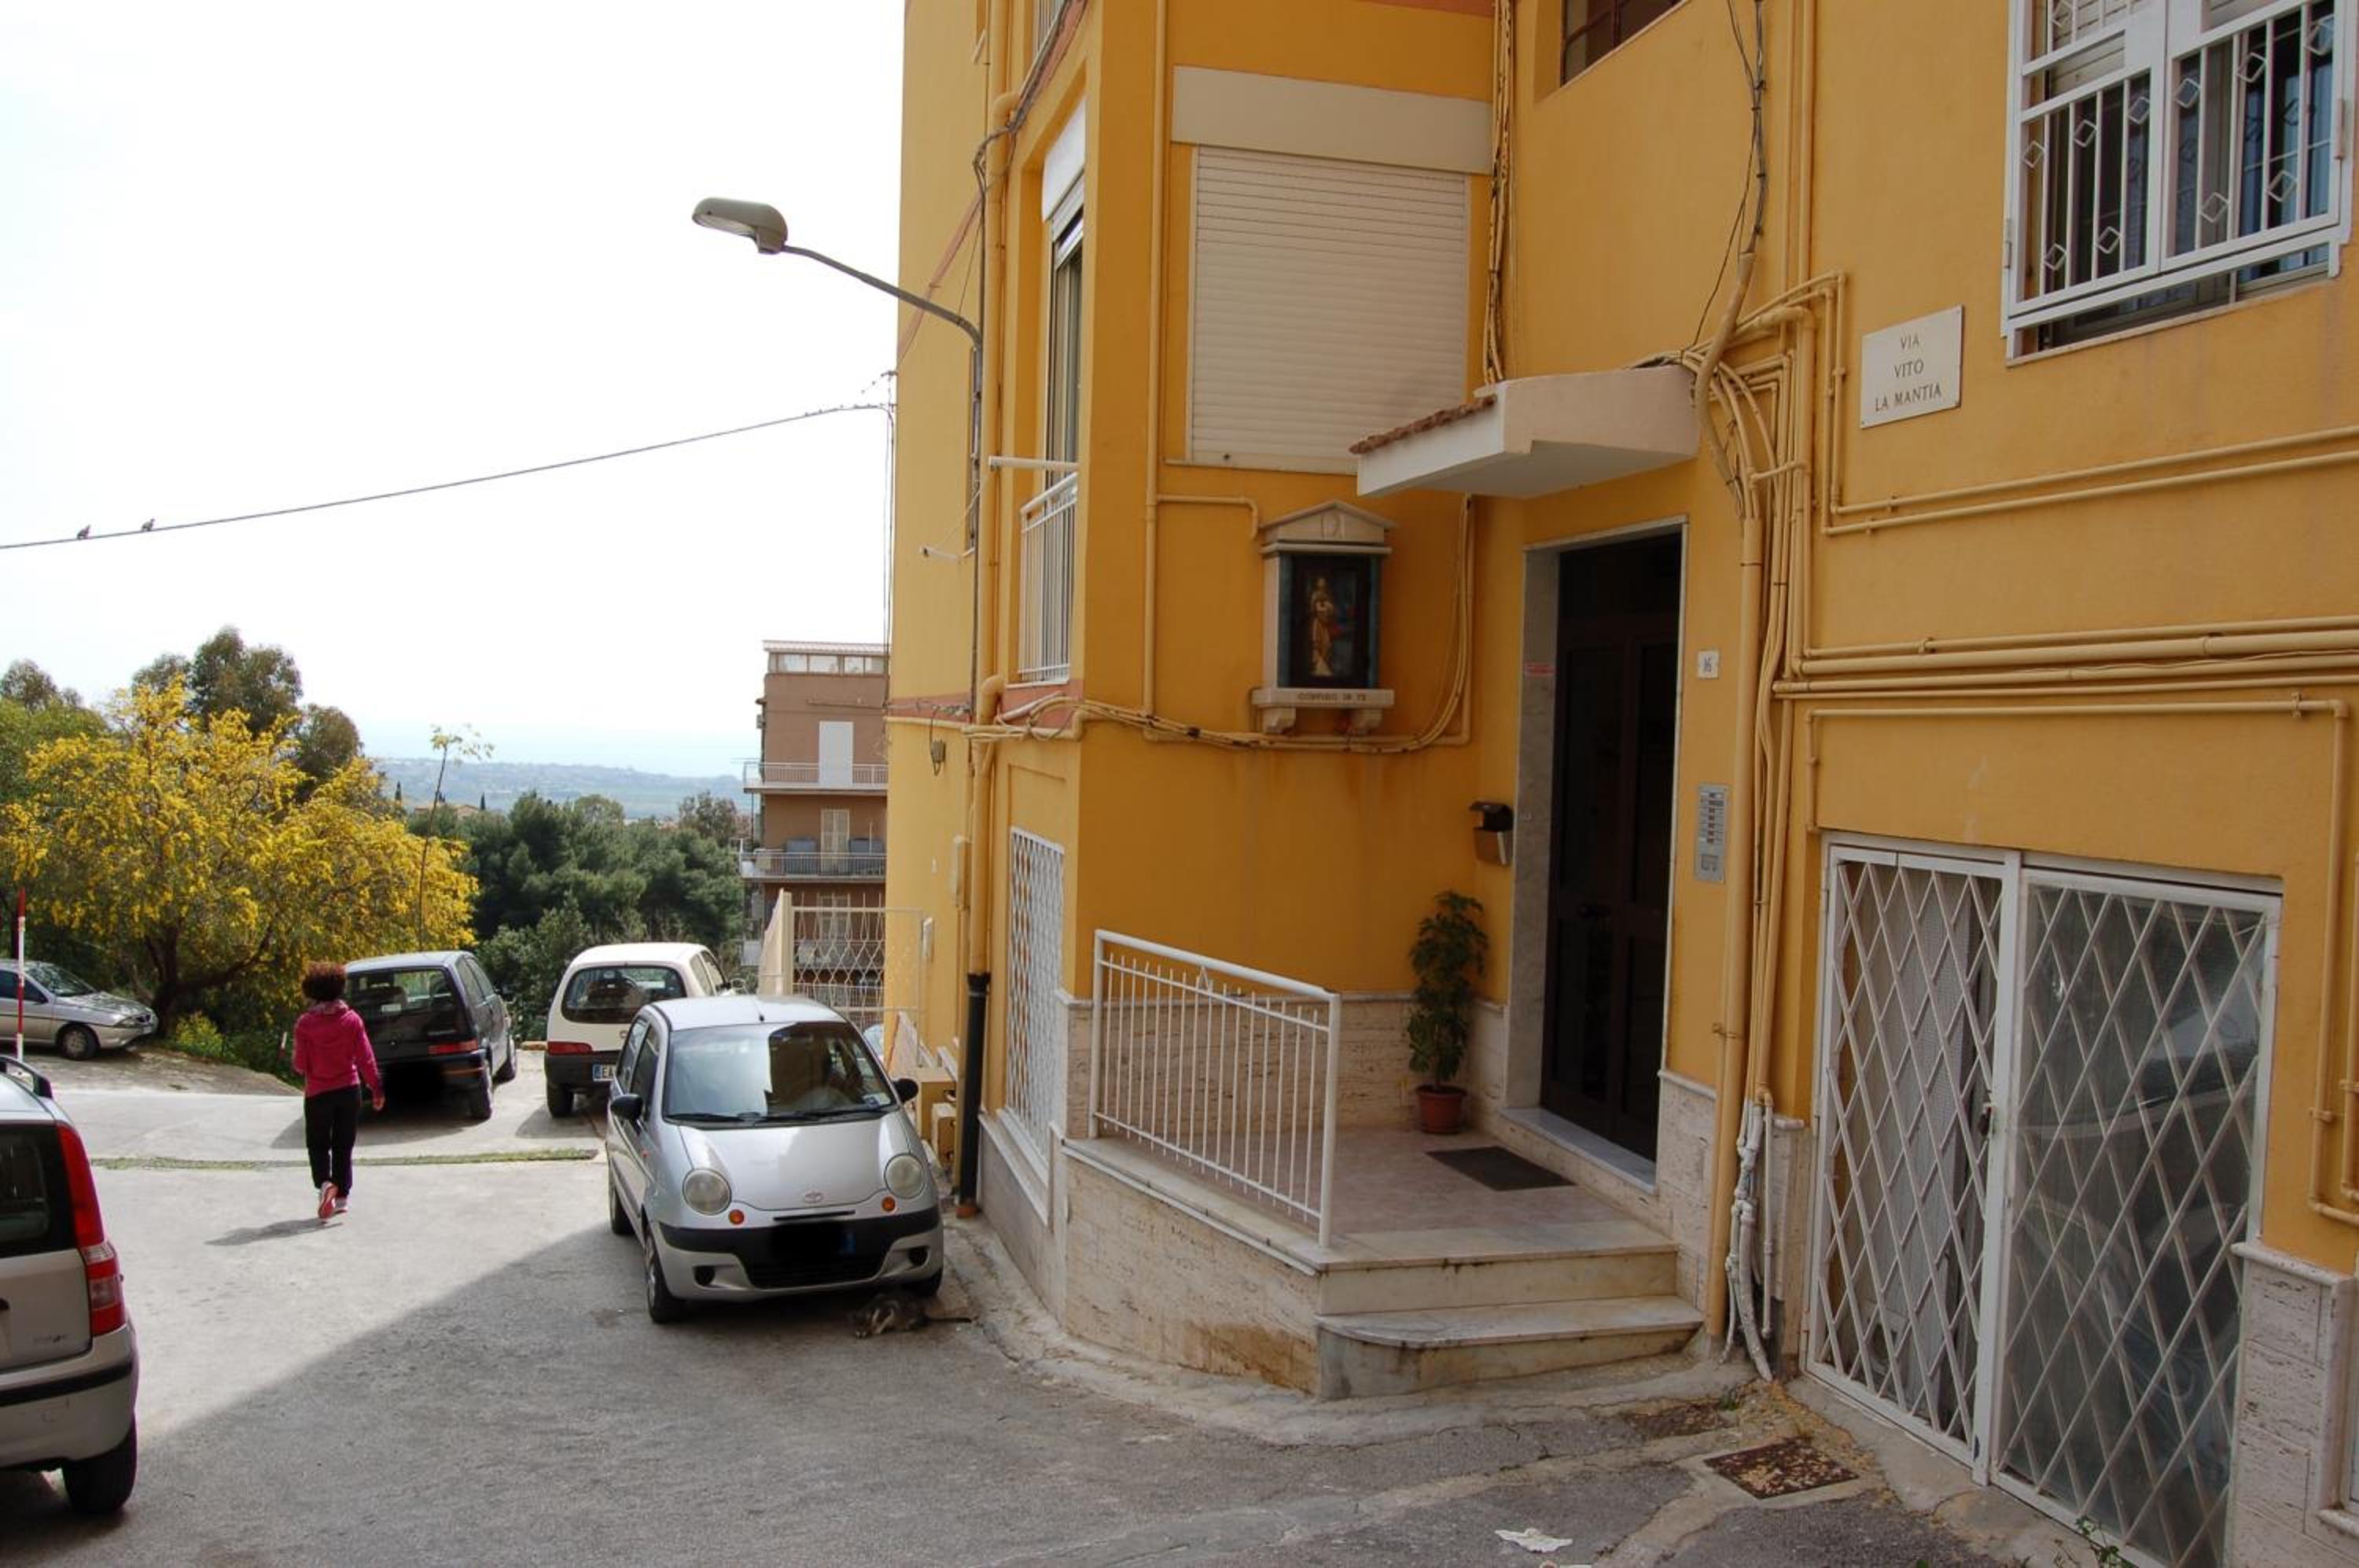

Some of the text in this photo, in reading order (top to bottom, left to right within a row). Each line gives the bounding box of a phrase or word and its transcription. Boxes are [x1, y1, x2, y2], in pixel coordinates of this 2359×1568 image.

[1900, 333, 1919, 351] VIA
[1893, 359, 1924, 378] VITO
[1875, 382, 1942, 412] LA MANTIA
